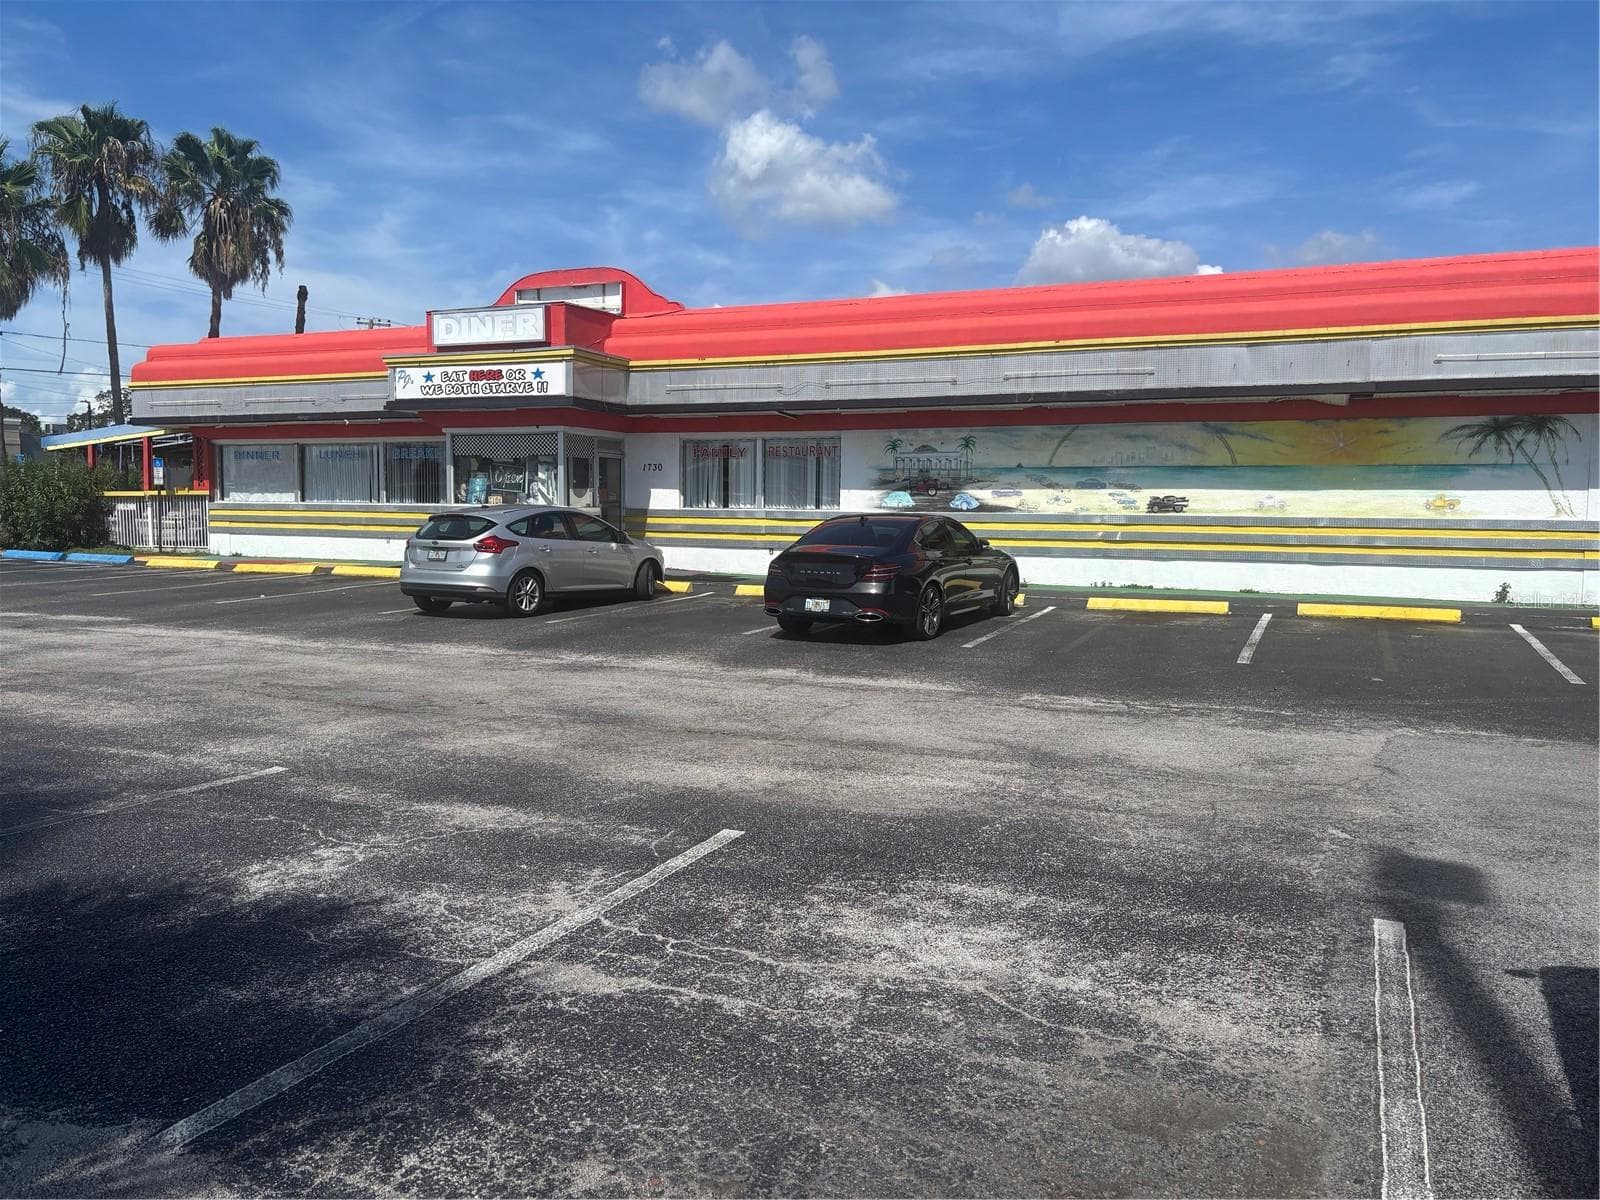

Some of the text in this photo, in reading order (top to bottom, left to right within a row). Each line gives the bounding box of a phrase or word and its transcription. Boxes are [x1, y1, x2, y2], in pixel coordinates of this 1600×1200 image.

[437, 312, 537, 340] DINER
[441, 368, 526, 383] EAT HERE OR
[420, 383, 443, 396] WE
[445, 382, 481, 395] BOTH
[482, 381, 534, 395] STARVE
[233, 449, 281, 461] DINNER
[318, 448, 361, 461] LUNCH
[692, 445, 747, 460] FAMILY
[767, 444, 839, 458] RESTAURANT
[643, 463, 663, 472] 1730
